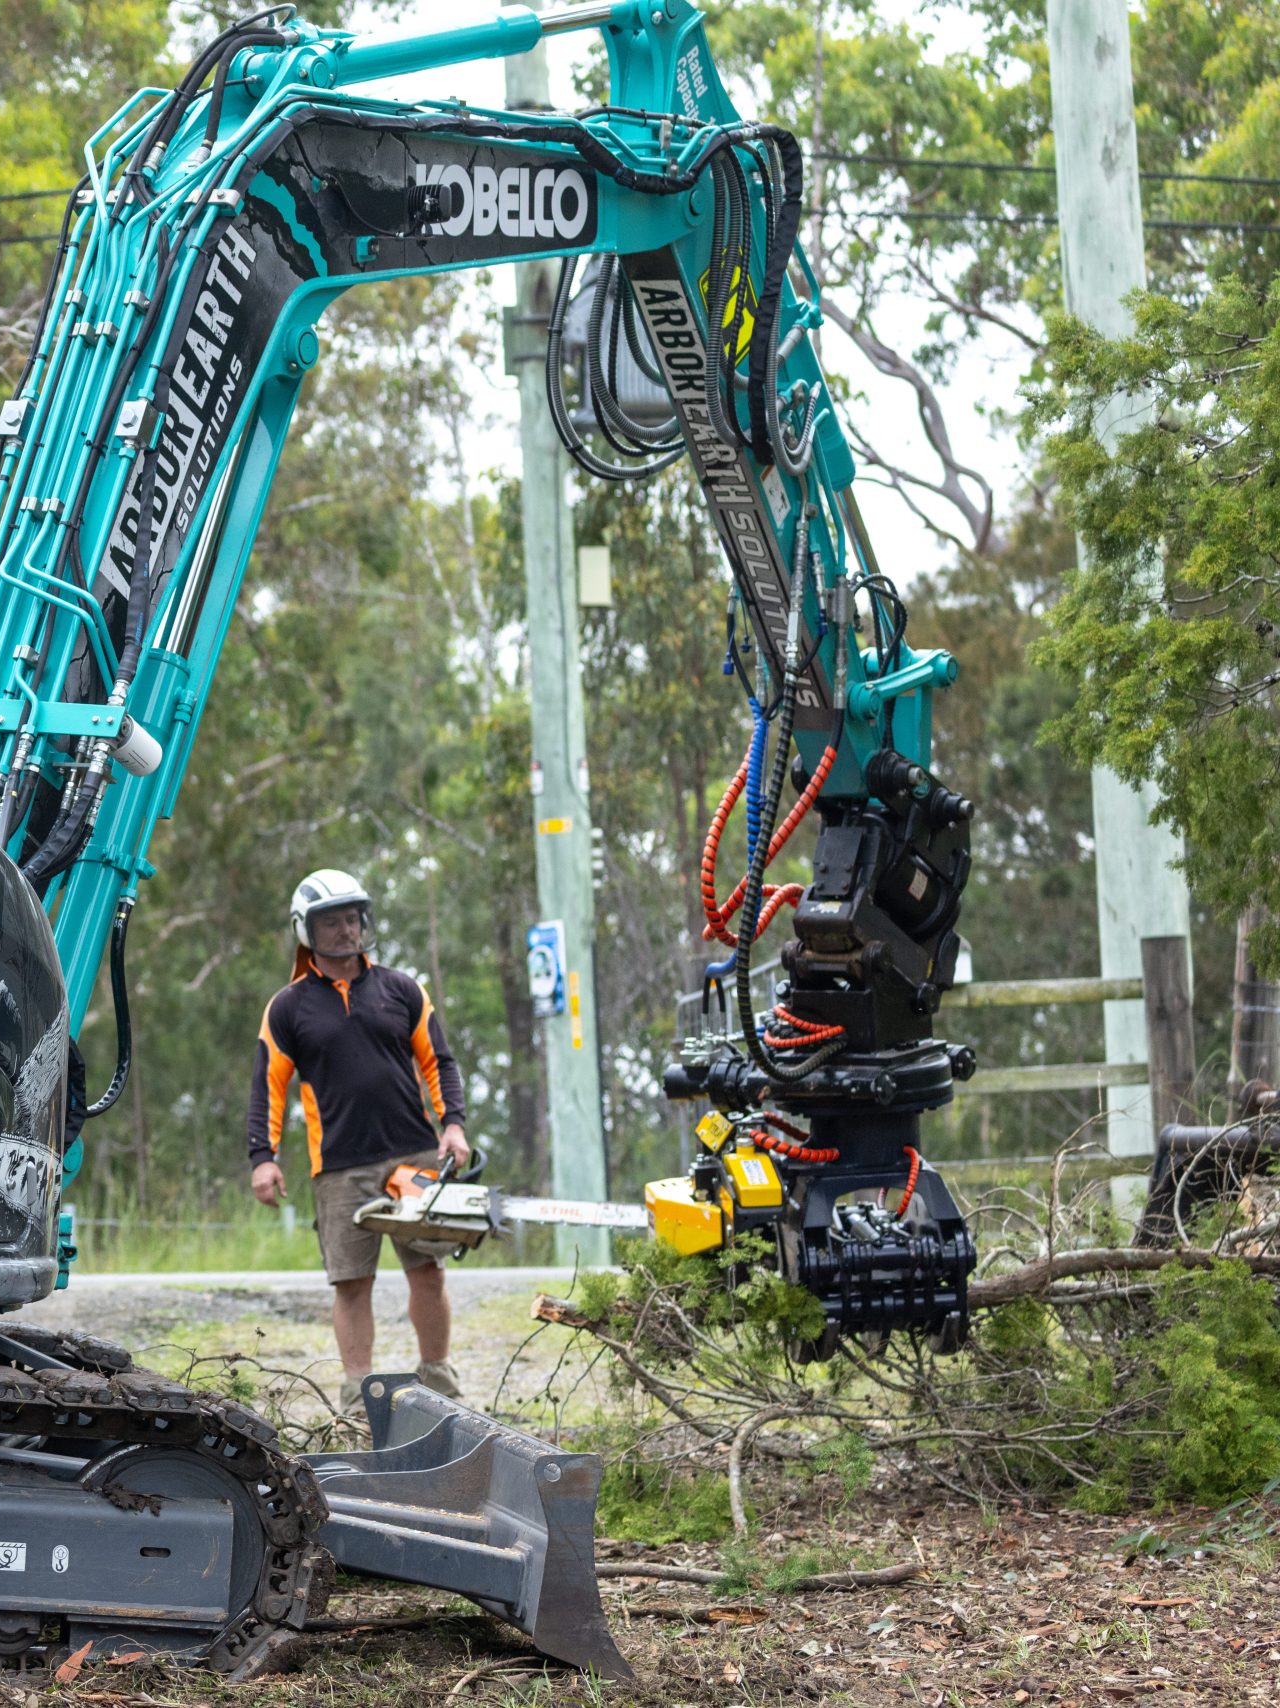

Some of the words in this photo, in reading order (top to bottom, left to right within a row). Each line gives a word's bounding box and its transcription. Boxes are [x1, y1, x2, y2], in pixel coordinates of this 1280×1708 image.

[676, 56, 699, 119] Capacit
[686, 45, 708, 98] Rated
[172, 223, 257, 410] EARTH
[175, 353, 243, 535] SOLUTIONS
[681, 402, 755, 503] EARTH
[538, 1204, 584, 1217] STIHL
